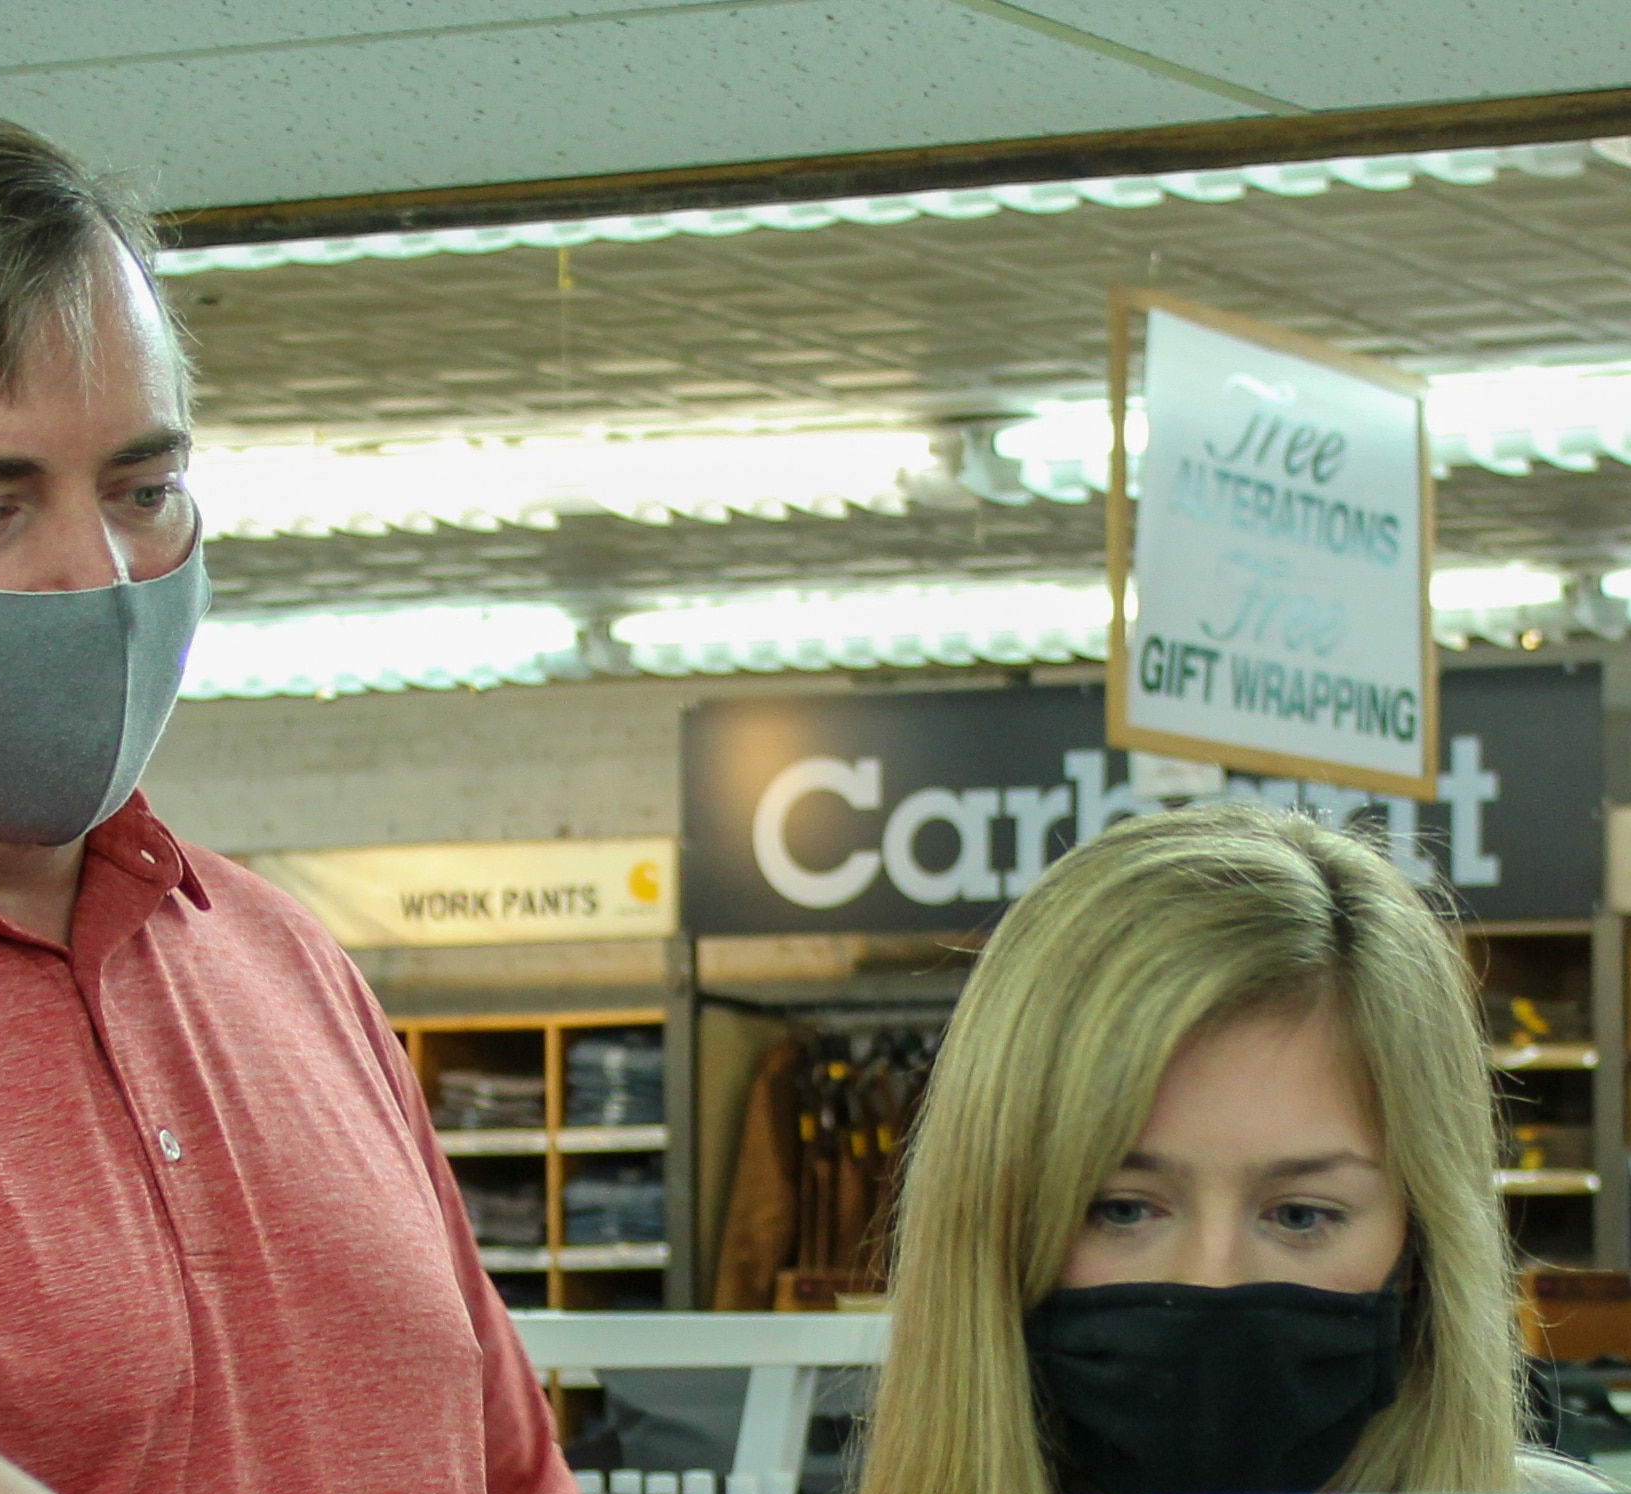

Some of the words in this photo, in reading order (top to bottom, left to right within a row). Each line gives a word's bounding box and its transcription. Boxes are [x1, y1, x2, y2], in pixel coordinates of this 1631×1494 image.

[1173, 458, 1401, 567] ALTERATIONS
[1141, 634, 1219, 703] GIFT
[1231, 655, 1416, 742] WRAPPING
[400, 891, 490, 920] WORK
[502, 886, 598, 919] PANTS
